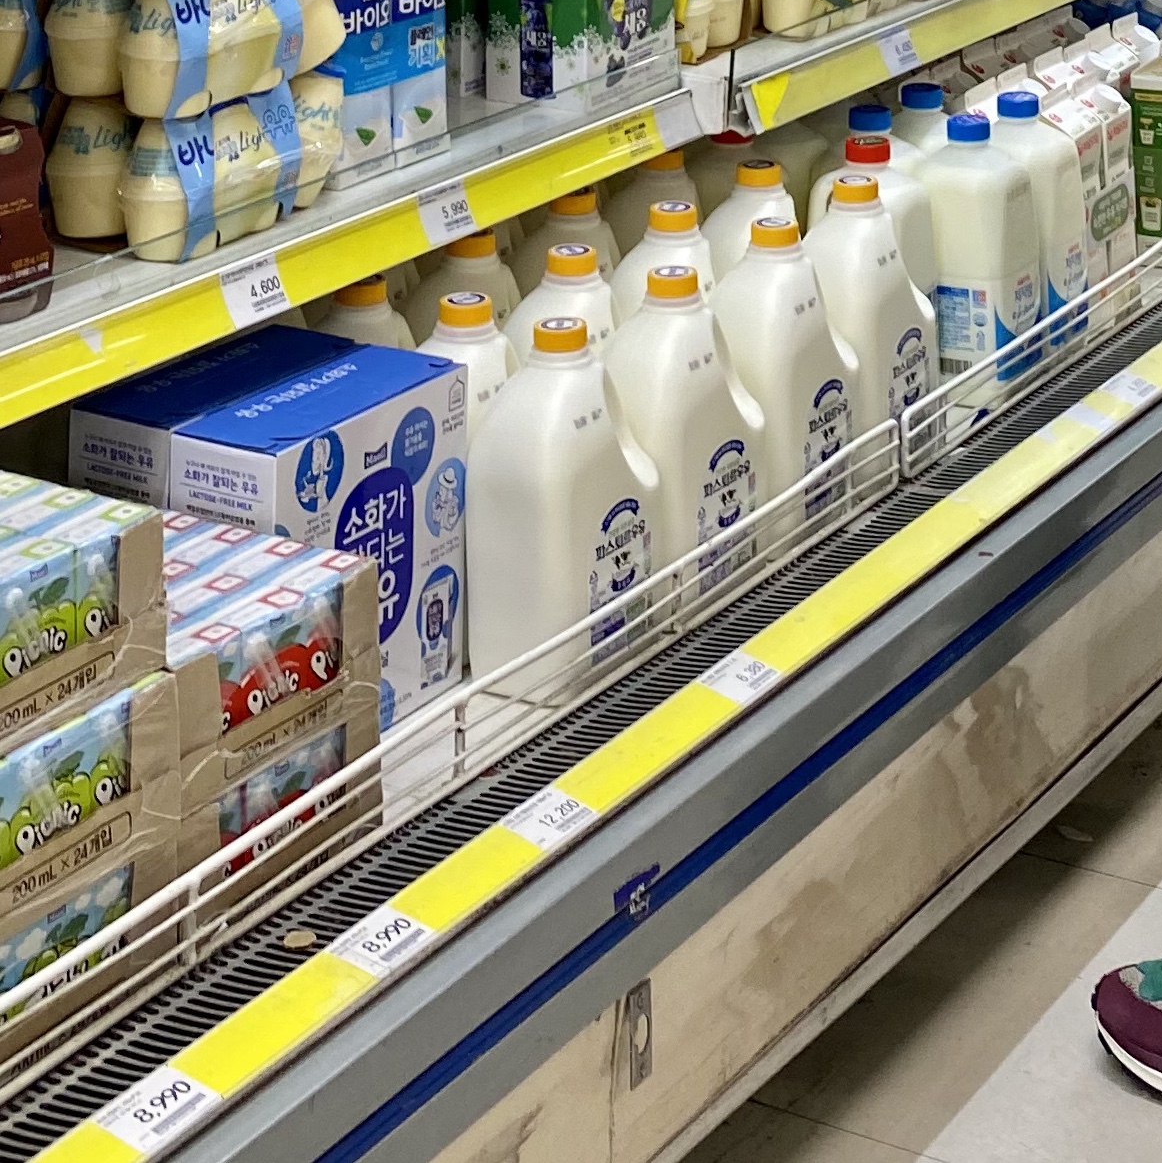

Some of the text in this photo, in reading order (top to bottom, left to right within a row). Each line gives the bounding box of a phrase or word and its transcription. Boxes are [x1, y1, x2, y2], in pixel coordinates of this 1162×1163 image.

[442, 199, 469, 220] 5,990
[250, 276, 281, 298] 4,600
[183, 467, 210, 483] 소화가
[240, 479, 259, 496] 우유
[342, 483, 407, 545] 소화가
[538, 798, 580, 828] 12,200
[362, 917, 412, 954] 8,990
[133, 1080, 192, 1124] 8,990
